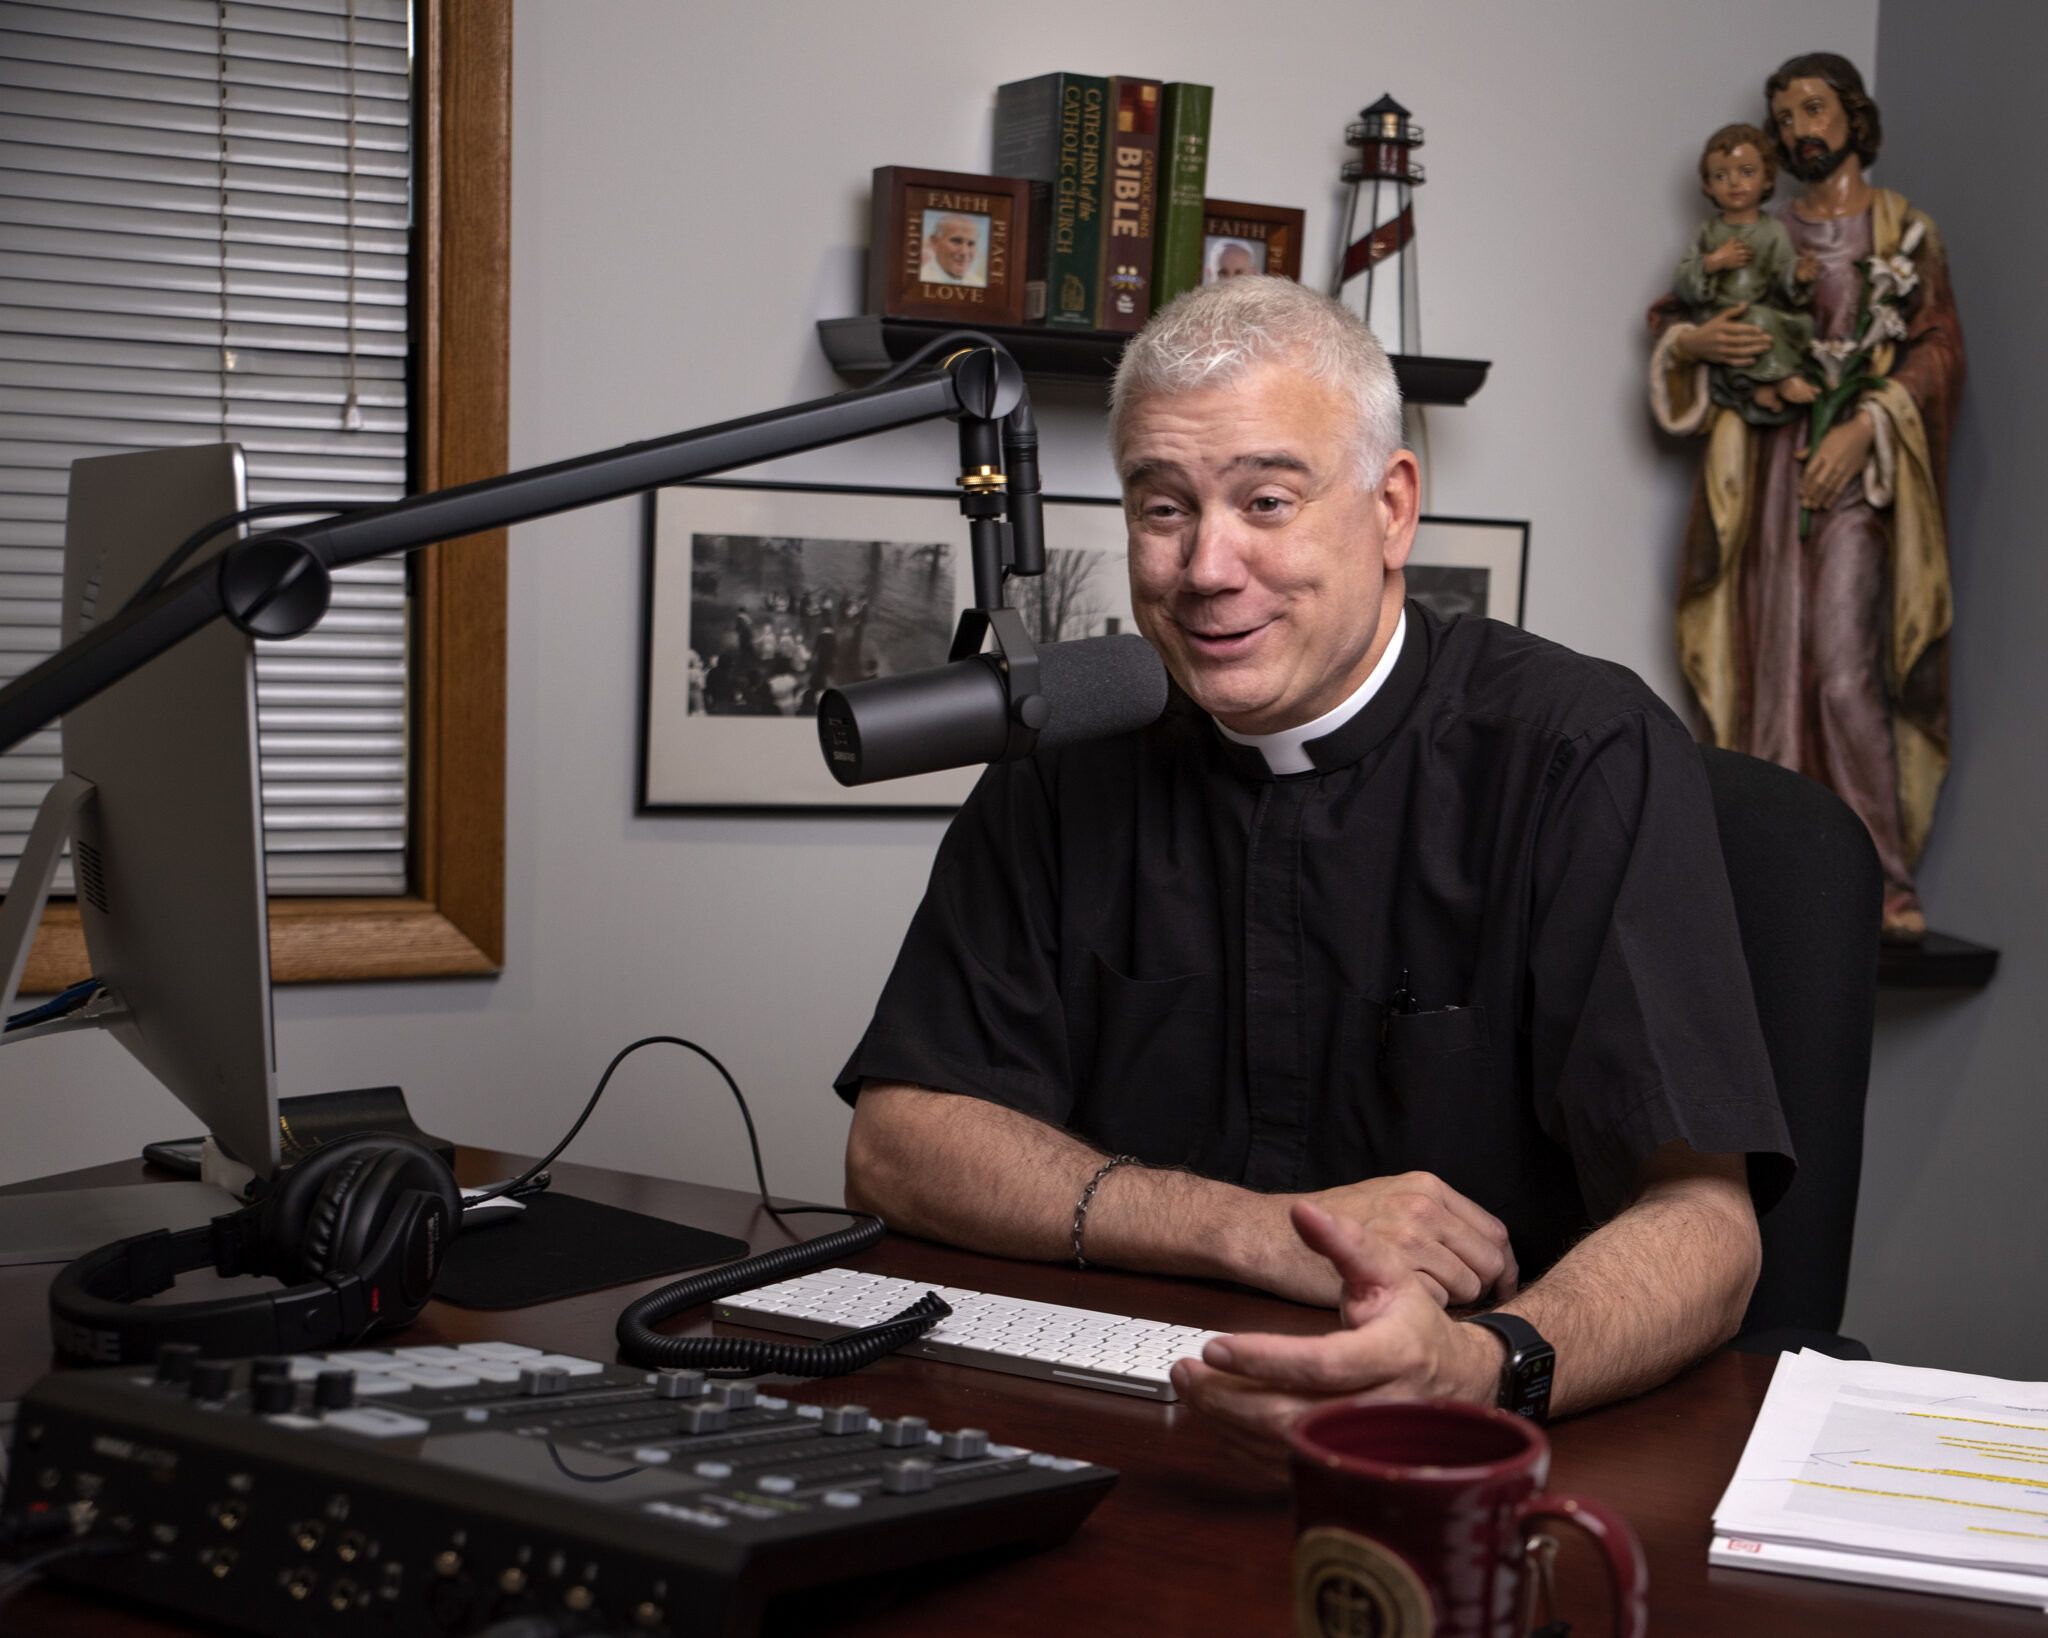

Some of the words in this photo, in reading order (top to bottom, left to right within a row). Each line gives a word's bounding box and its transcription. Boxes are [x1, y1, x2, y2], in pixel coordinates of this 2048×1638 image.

[1061, 86, 1081, 176] CATHOLIC
[1080, 88, 1101, 186] CATECHISM
[928, 193, 988, 212] FAITH
[1057, 177, 1077, 254] CHURCH
[1112, 147, 1142, 237] BIBLE
[906, 212, 921, 274] HOPE
[992, 220, 1006, 284] PEACE
[1208, 219, 1266, 238] FAITH
[924, 285, 984, 303] LOVE
